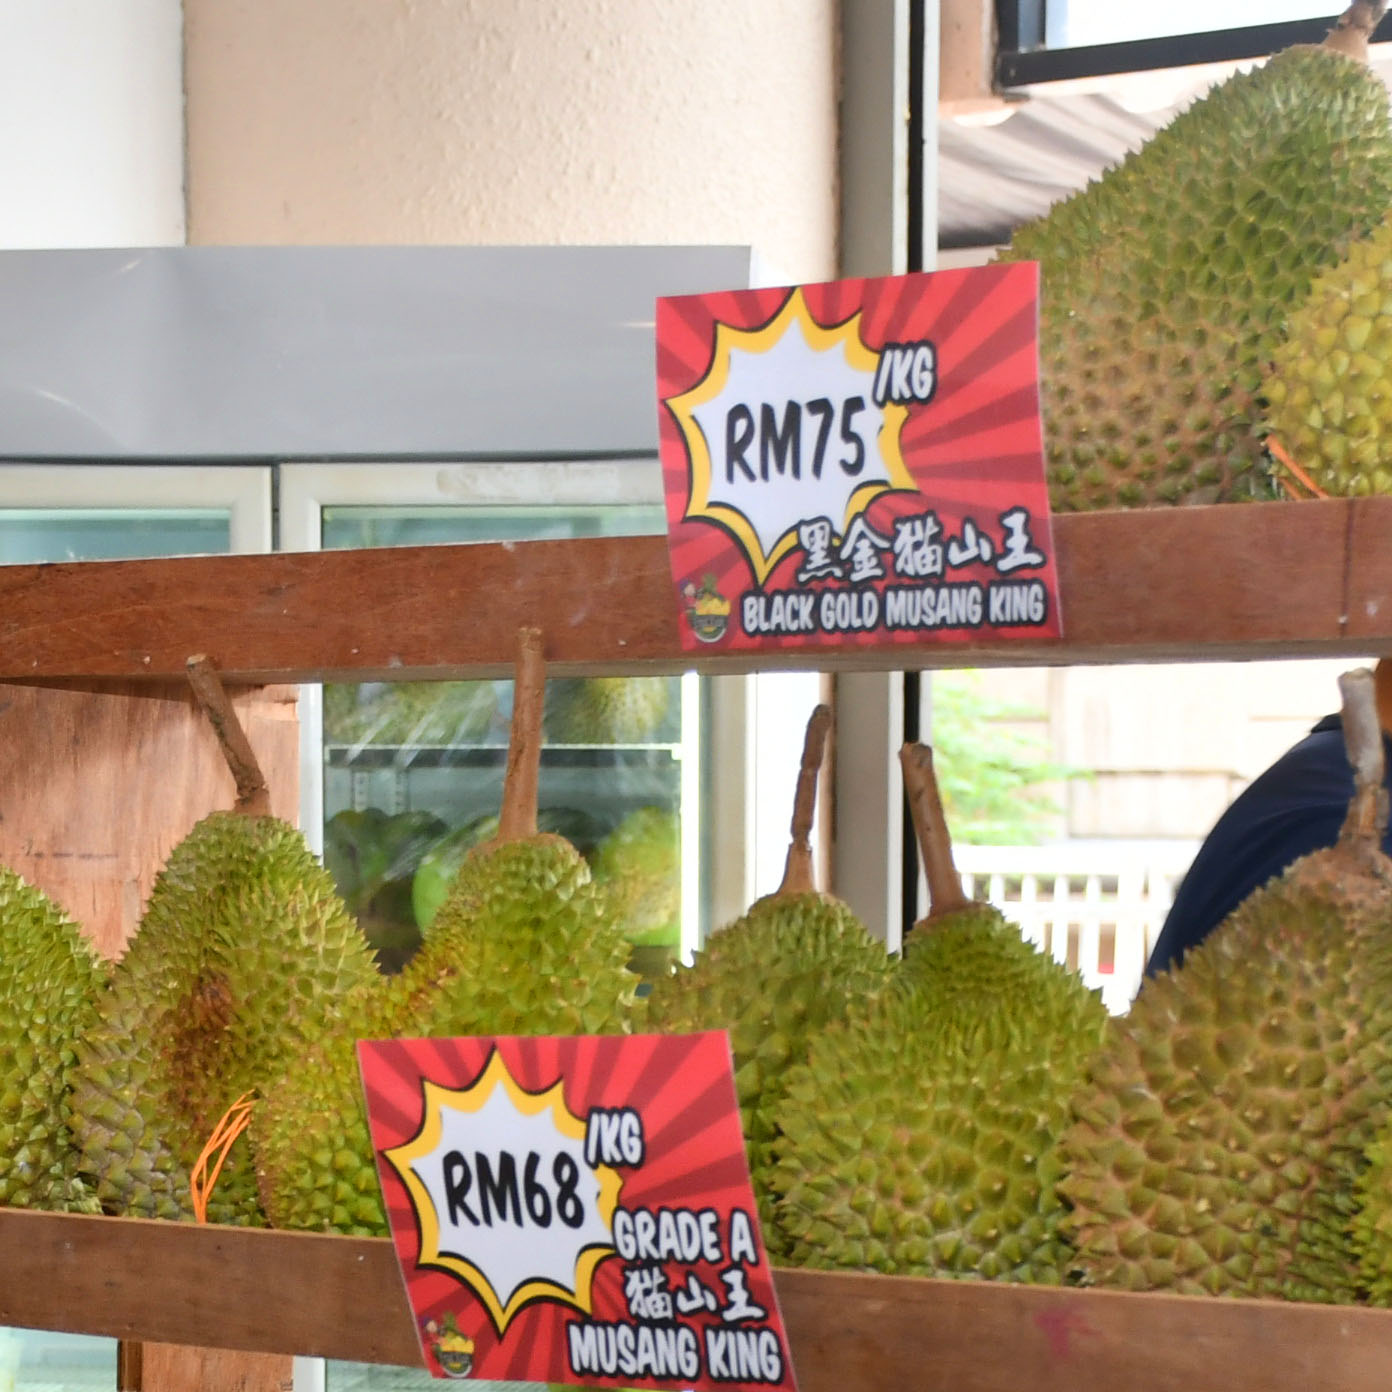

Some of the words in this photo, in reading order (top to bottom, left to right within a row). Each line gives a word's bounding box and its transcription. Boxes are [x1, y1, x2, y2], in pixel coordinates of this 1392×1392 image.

[725, 395, 866, 483] RM75
[742, 592, 814, 634] BLACK
[820, 591, 878, 630] GOLD
[886, 587, 982, 628] MUSANG
[988, 583, 1045, 623] KING
[442, 1150, 585, 1229] RM68
[614, 1210, 722, 1262] GRADE
[730, 1210, 756, 1263] A
[567, 1324, 700, 1378] MUSANG
[706, 1329, 782, 1381] KING
